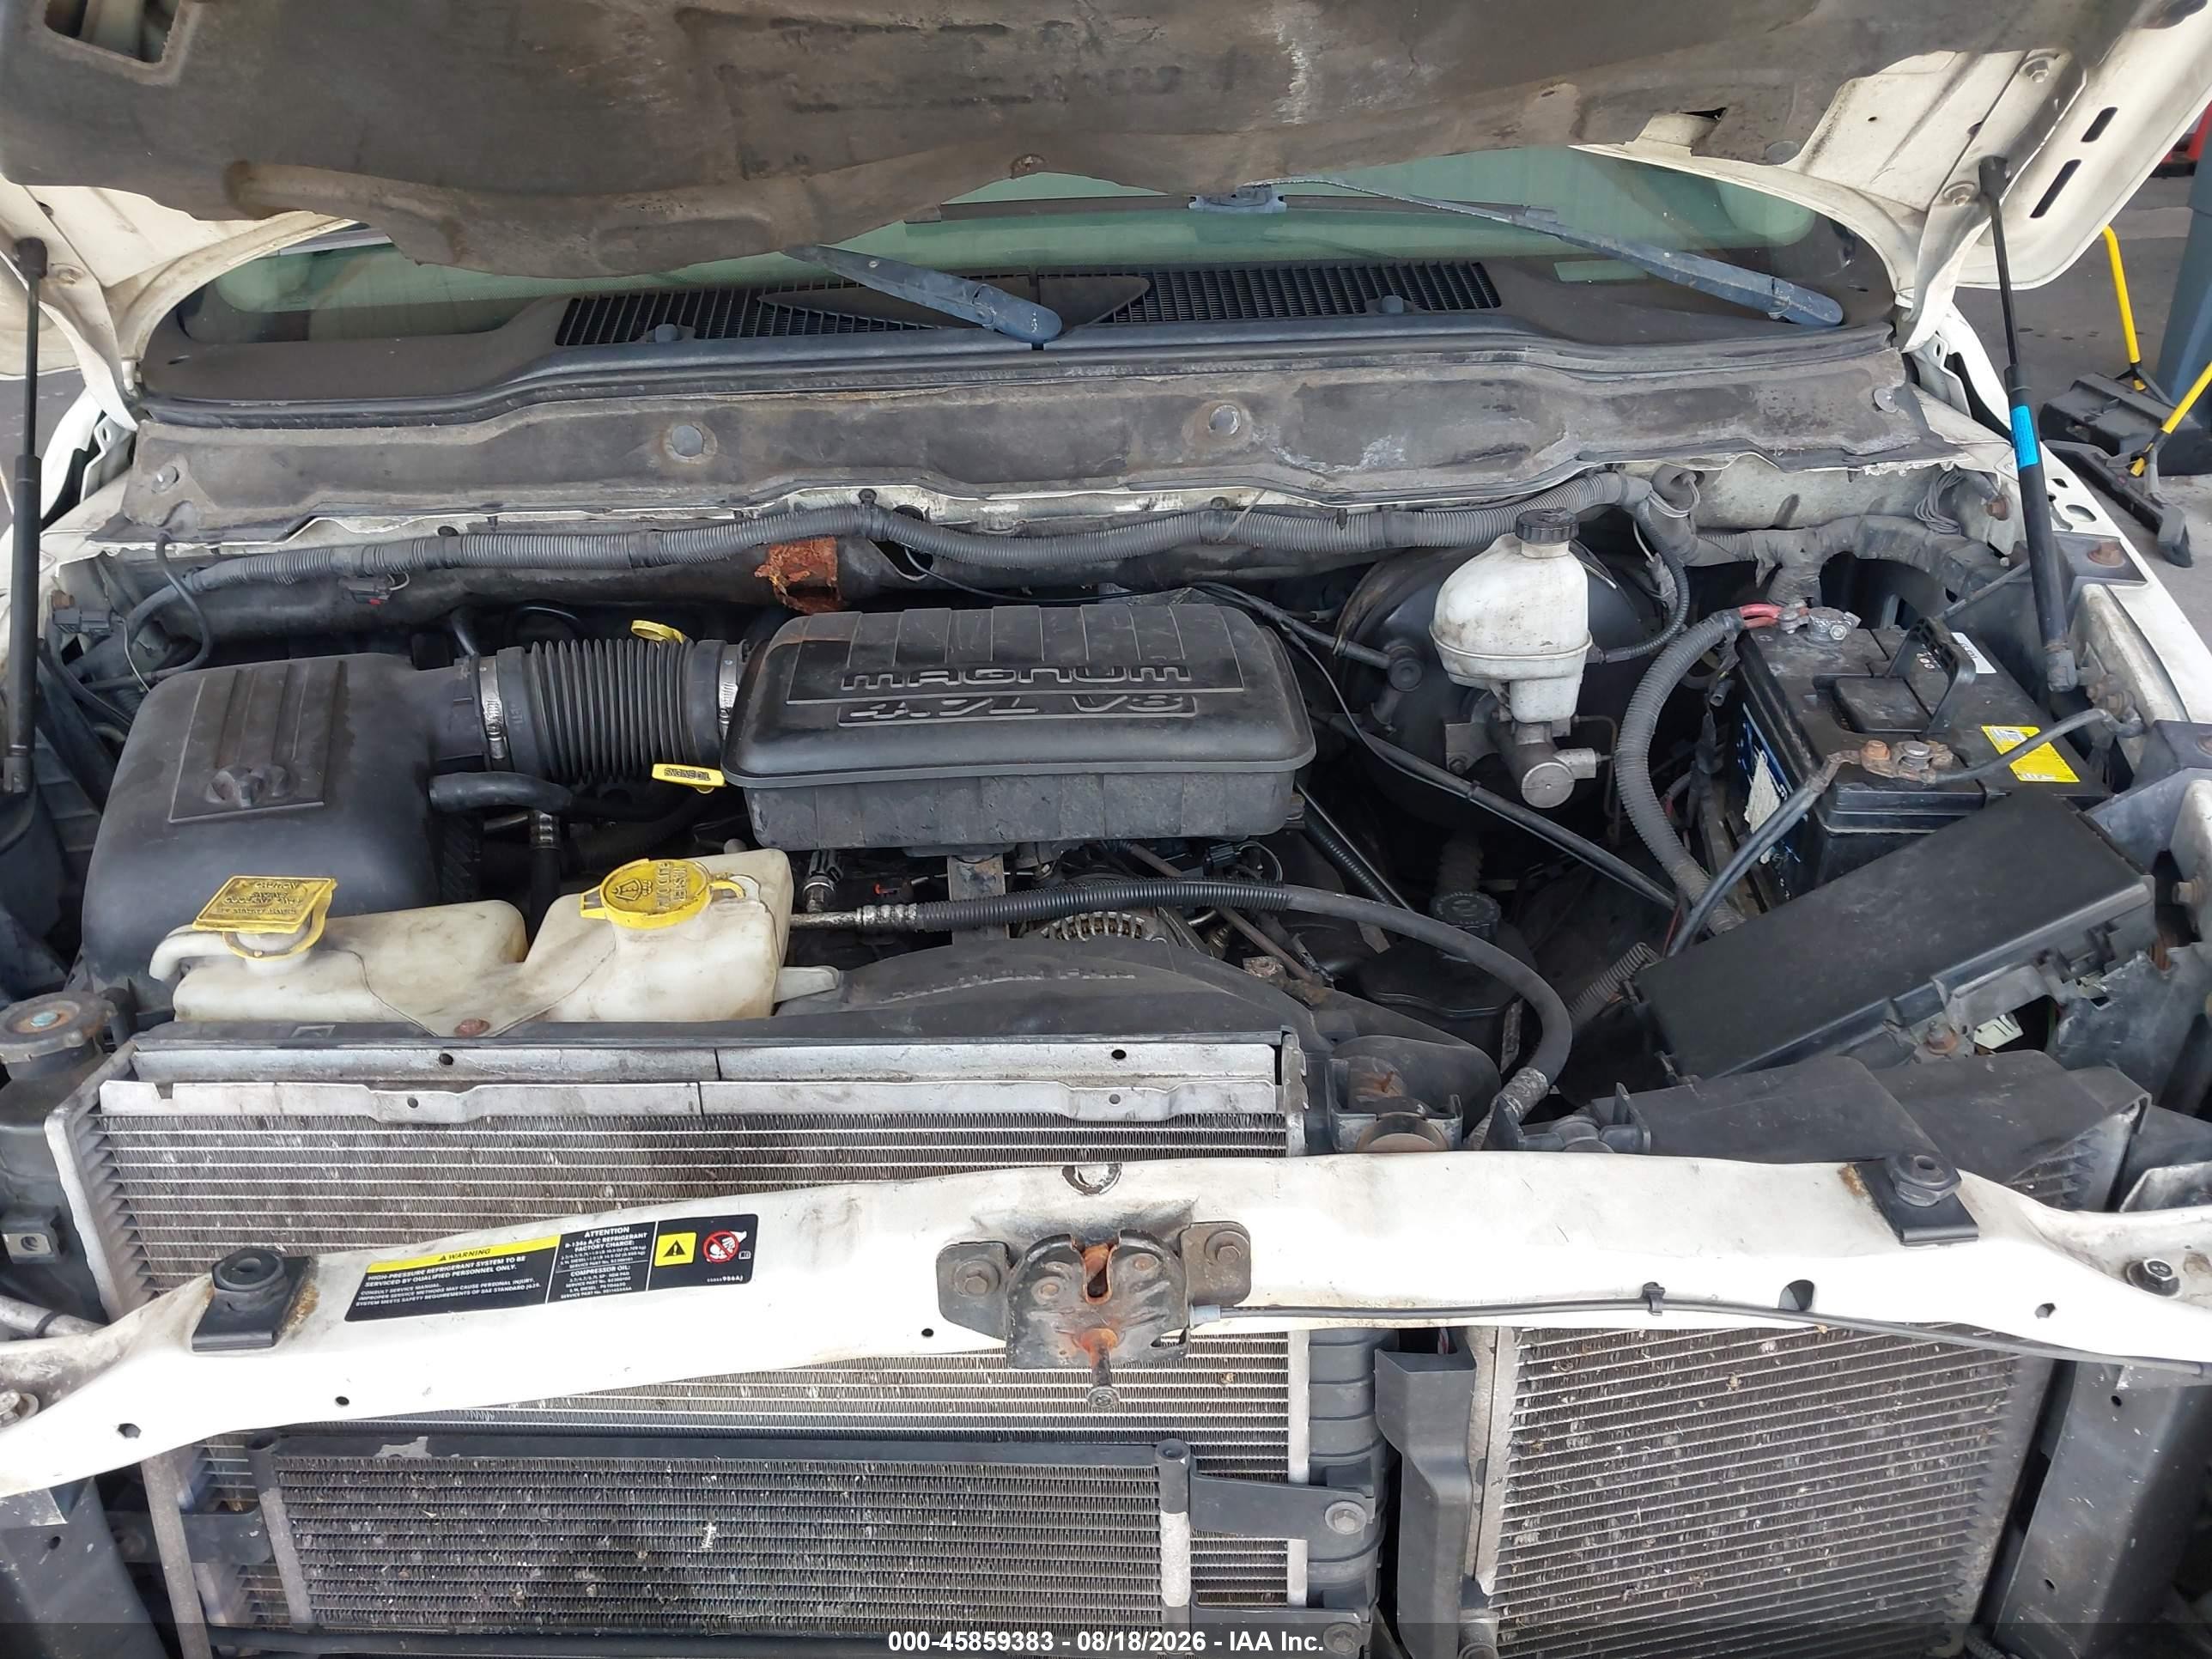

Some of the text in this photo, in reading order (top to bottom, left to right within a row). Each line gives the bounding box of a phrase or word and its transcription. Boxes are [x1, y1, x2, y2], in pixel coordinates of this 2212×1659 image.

[841, 665, 1193, 690] MAGNUM
[849, 695, 1183, 719] 4.7L V8
[665, 768, 696, 779] ENGINE
[585, 1226, 630, 1238] ATTENTION
[602, 1232, 647, 1243] REFRIGERANT
[574, 1243, 605, 1253] FACTORY
[605, 1240, 635, 1249] CHARGE:
[448, 1248, 491, 1261] WARNING
[365, 1278, 401, 1287] SERVICED
[412, 1272, 451, 1282] QUALIFIED
[452, 1267, 495, 1278] PERSONNEL
[495, 1264, 517, 1273] ONLY.
[368, 1269, 425, 1280] HIGH-PRESSURE
[427, 1262, 474, 1274] REFRIGERANT
[476, 1258, 504, 1267] SYSTEM
[570, 1267, 617, 1277] COMPRESSOR
[389, 1285, 413, 1294] SERVICE
[480, 1280, 511, 1289] PERSONAL
[424, 1290, 471, 1300] REQUIREMENTS
[493, 1285, 525, 1293] STANDARD
